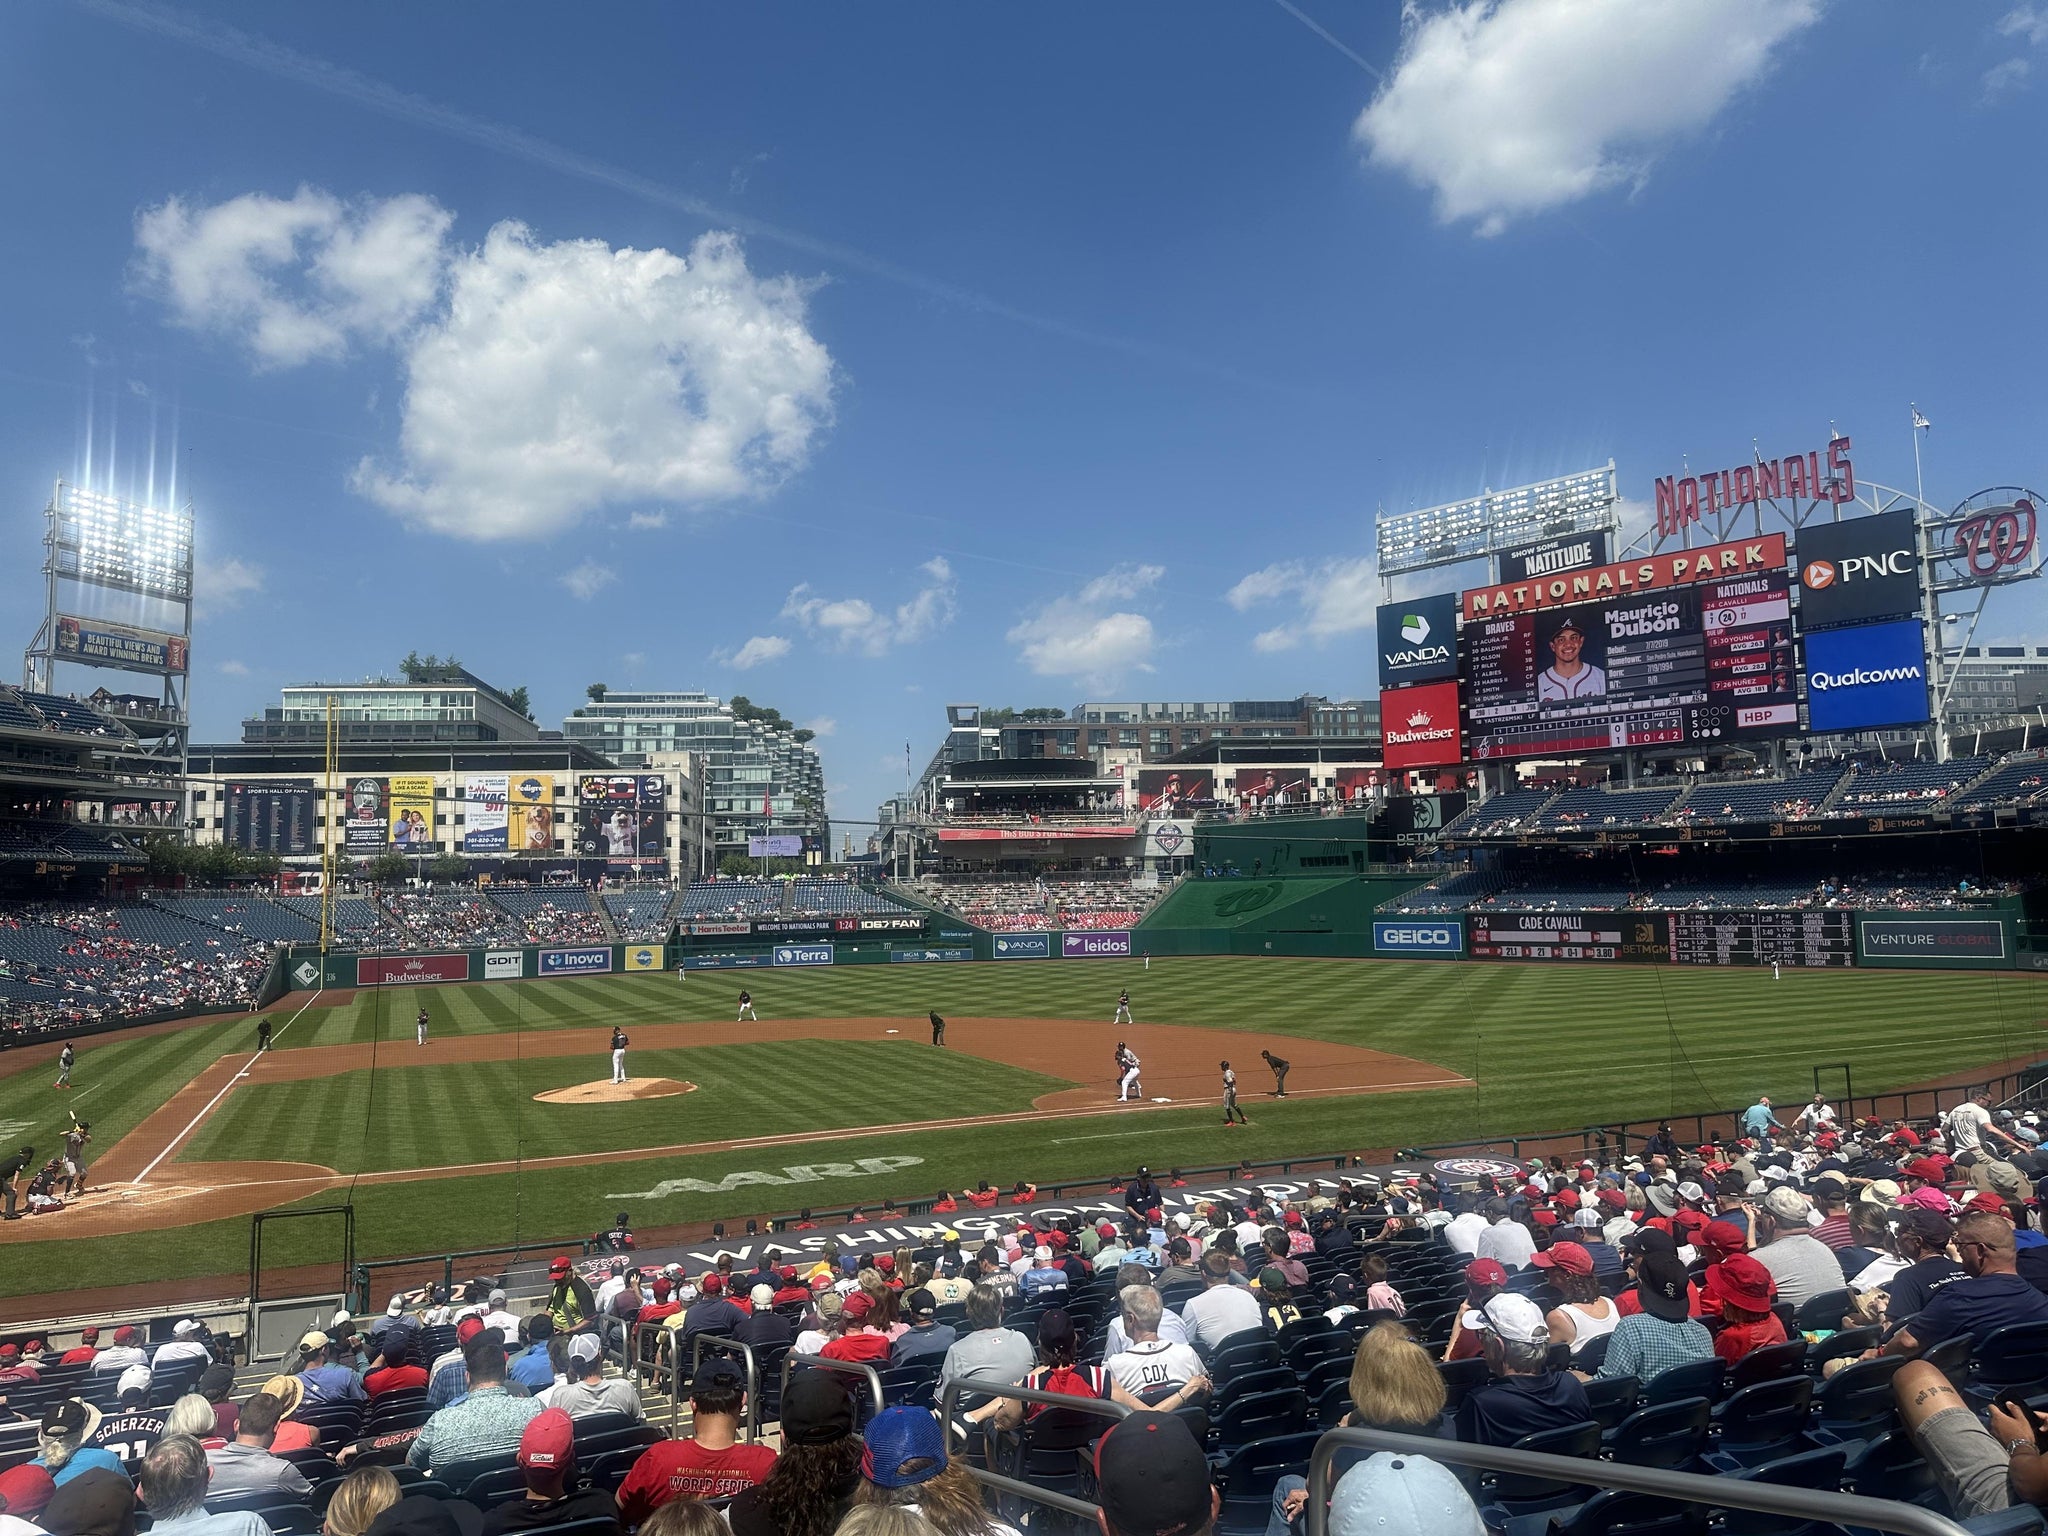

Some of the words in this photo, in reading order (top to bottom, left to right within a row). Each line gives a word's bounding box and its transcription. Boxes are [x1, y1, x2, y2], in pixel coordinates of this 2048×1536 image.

[1655, 436, 1855, 537] NATIONALS
[1511, 547, 1535, 559] SHOW
[1536, 541, 1559, 552] SOME
[1525, 541, 1592, 576] NATITUDE
[1838, 550, 1912, 582] PNC
[1473, 564, 1653, 612] NATIONALS
[1673, 544, 1764, 577] PARK
[1717, 579, 1769, 598] NATIONALS
[1718, 598, 1747, 607] CAVALLI
[1723, 613, 1732, 622] 24
[1485, 621, 1515, 635] BRAVES
[1729, 634, 1754, 642] YOUNG
[87, 634, 123, 648] BEAUTIFUL
[124, 640, 146, 652] VIEWS
[146, 645, 160, 654] AND
[1480, 644, 1508, 653] BALDWIN
[83, 643, 108, 656] AWARD
[109, 647, 141, 661] WINNING
[141, 654, 164, 665] BREWS
[1385, 646, 1450, 665] VANDA
[1481, 662, 1498, 670] RILEY
[1730, 657, 1746, 665] LILE
[1481, 669, 1502, 677] ALBIES
[1732, 678, 1757, 687] NUÑEZ
[1811, 666, 1920, 691] Qualcomm
[1482, 686, 1500, 694] SMITH
[1691, 710, 1698, 718] B
[1744, 711, 1773, 722] HBP
[1484, 715, 1523, 725] YASTRZEMSKI
[1643, 722, 1650, 730] 0
[1658, 721, 1664, 729] 4
[1672, 719, 1678, 727] 2
[1386, 728, 1454, 744] Budweiser
[1644, 734, 1650, 742] 0
[1658, 732, 1664, 740] 4
[1673, 731, 1679, 740] 2
[514, 785, 547, 793] Pedigree
[473, 793, 506, 801] HVAC
[485, 803, 504, 811] 911
[1785, 824, 1821, 833] BETMGM
[1885, 819, 1925, 828] BETMGM
[1608, 832, 1639, 841] BETMGM
[1693, 829, 1726, 838] BETMGM
[47, 864, 76, 872] BETMGM
[698, 925, 722, 933] Harris
[723, 924, 749, 932] Teeter
[839, 921, 853, 930] 1:24
[892, 920, 920, 928] FAN
[1519, 917, 1543, 930] CADE
[1545, 917, 1582, 930] CAVALLI
[1383, 929, 1450, 945] GEICO
[1871, 934, 1934, 944] VENTURE
[1938, 934, 1995, 945] GLOBAL
[1084, 939, 1128, 952] leidos
[1623, 944, 1669, 954] BETMGM
[793, 950, 829, 961] Terra
[1537, 948, 1545, 956] 21
[1568, 947, 1578, 957] 0-1
[1596, 949, 1612, 957] 3.80
[487, 956, 521, 965] GDIT
[565, 953, 604, 965] Inova
[326, 973, 336, 981] 336
[386, 972, 442, 982] Budweiser
[605, 1155, 925, 1199] AARP
[687, 1202, 1128, 1262] WASHINGTON
[1142, 1364, 1169, 1383] COX
[96, 1417, 164, 1442] SCHERZER
[676, 1467, 715, 1476] WASHINGTON
[718, 1469, 750, 1477] NATIONALS
[670, 1476, 714, 1493] WORLD
[715, 1478, 754, 1494] SERIES
